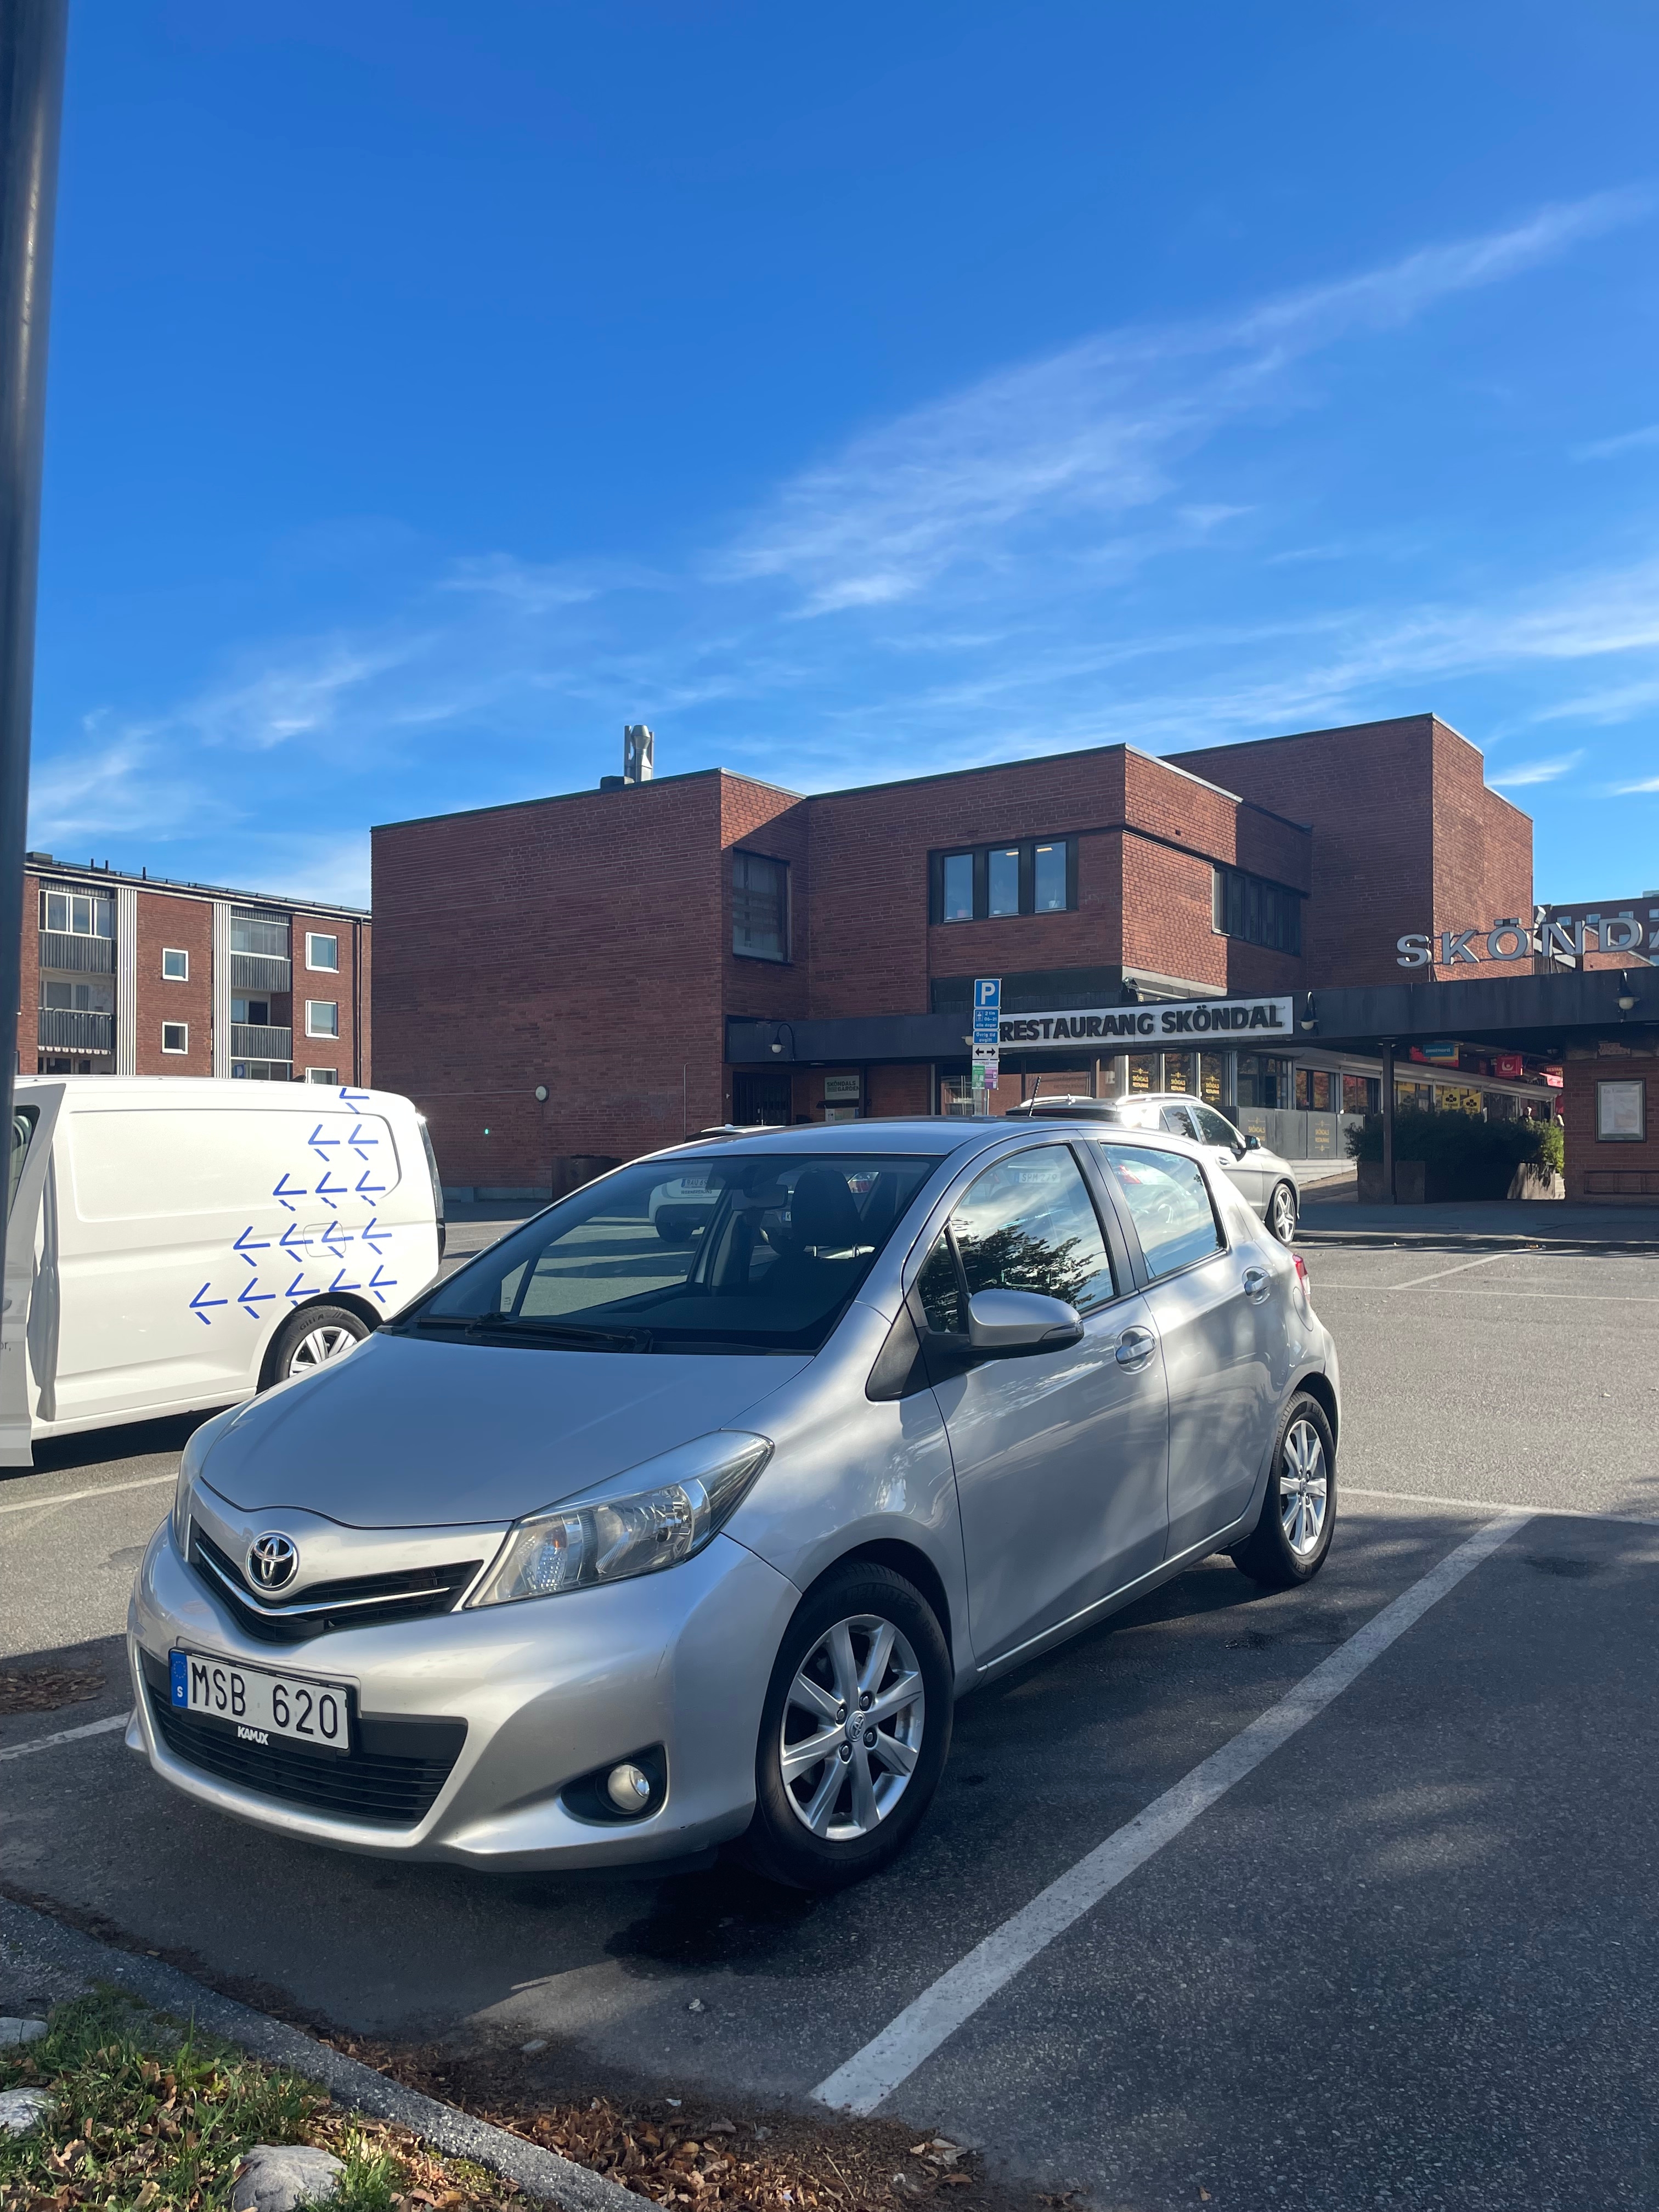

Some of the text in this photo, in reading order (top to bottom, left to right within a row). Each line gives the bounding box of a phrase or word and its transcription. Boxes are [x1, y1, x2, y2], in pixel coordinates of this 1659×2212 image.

[981, 982, 995, 1005] P
[1000, 1005, 1283, 1041] RESTAURANG SKÖNDAL
[1022, 1173, 1057, 1182] SPM 279
[177, 1685, 183, 1698] S
[191, 1662, 337, 1739] MSB 620
[238, 1726, 269, 1745] KAMUX
